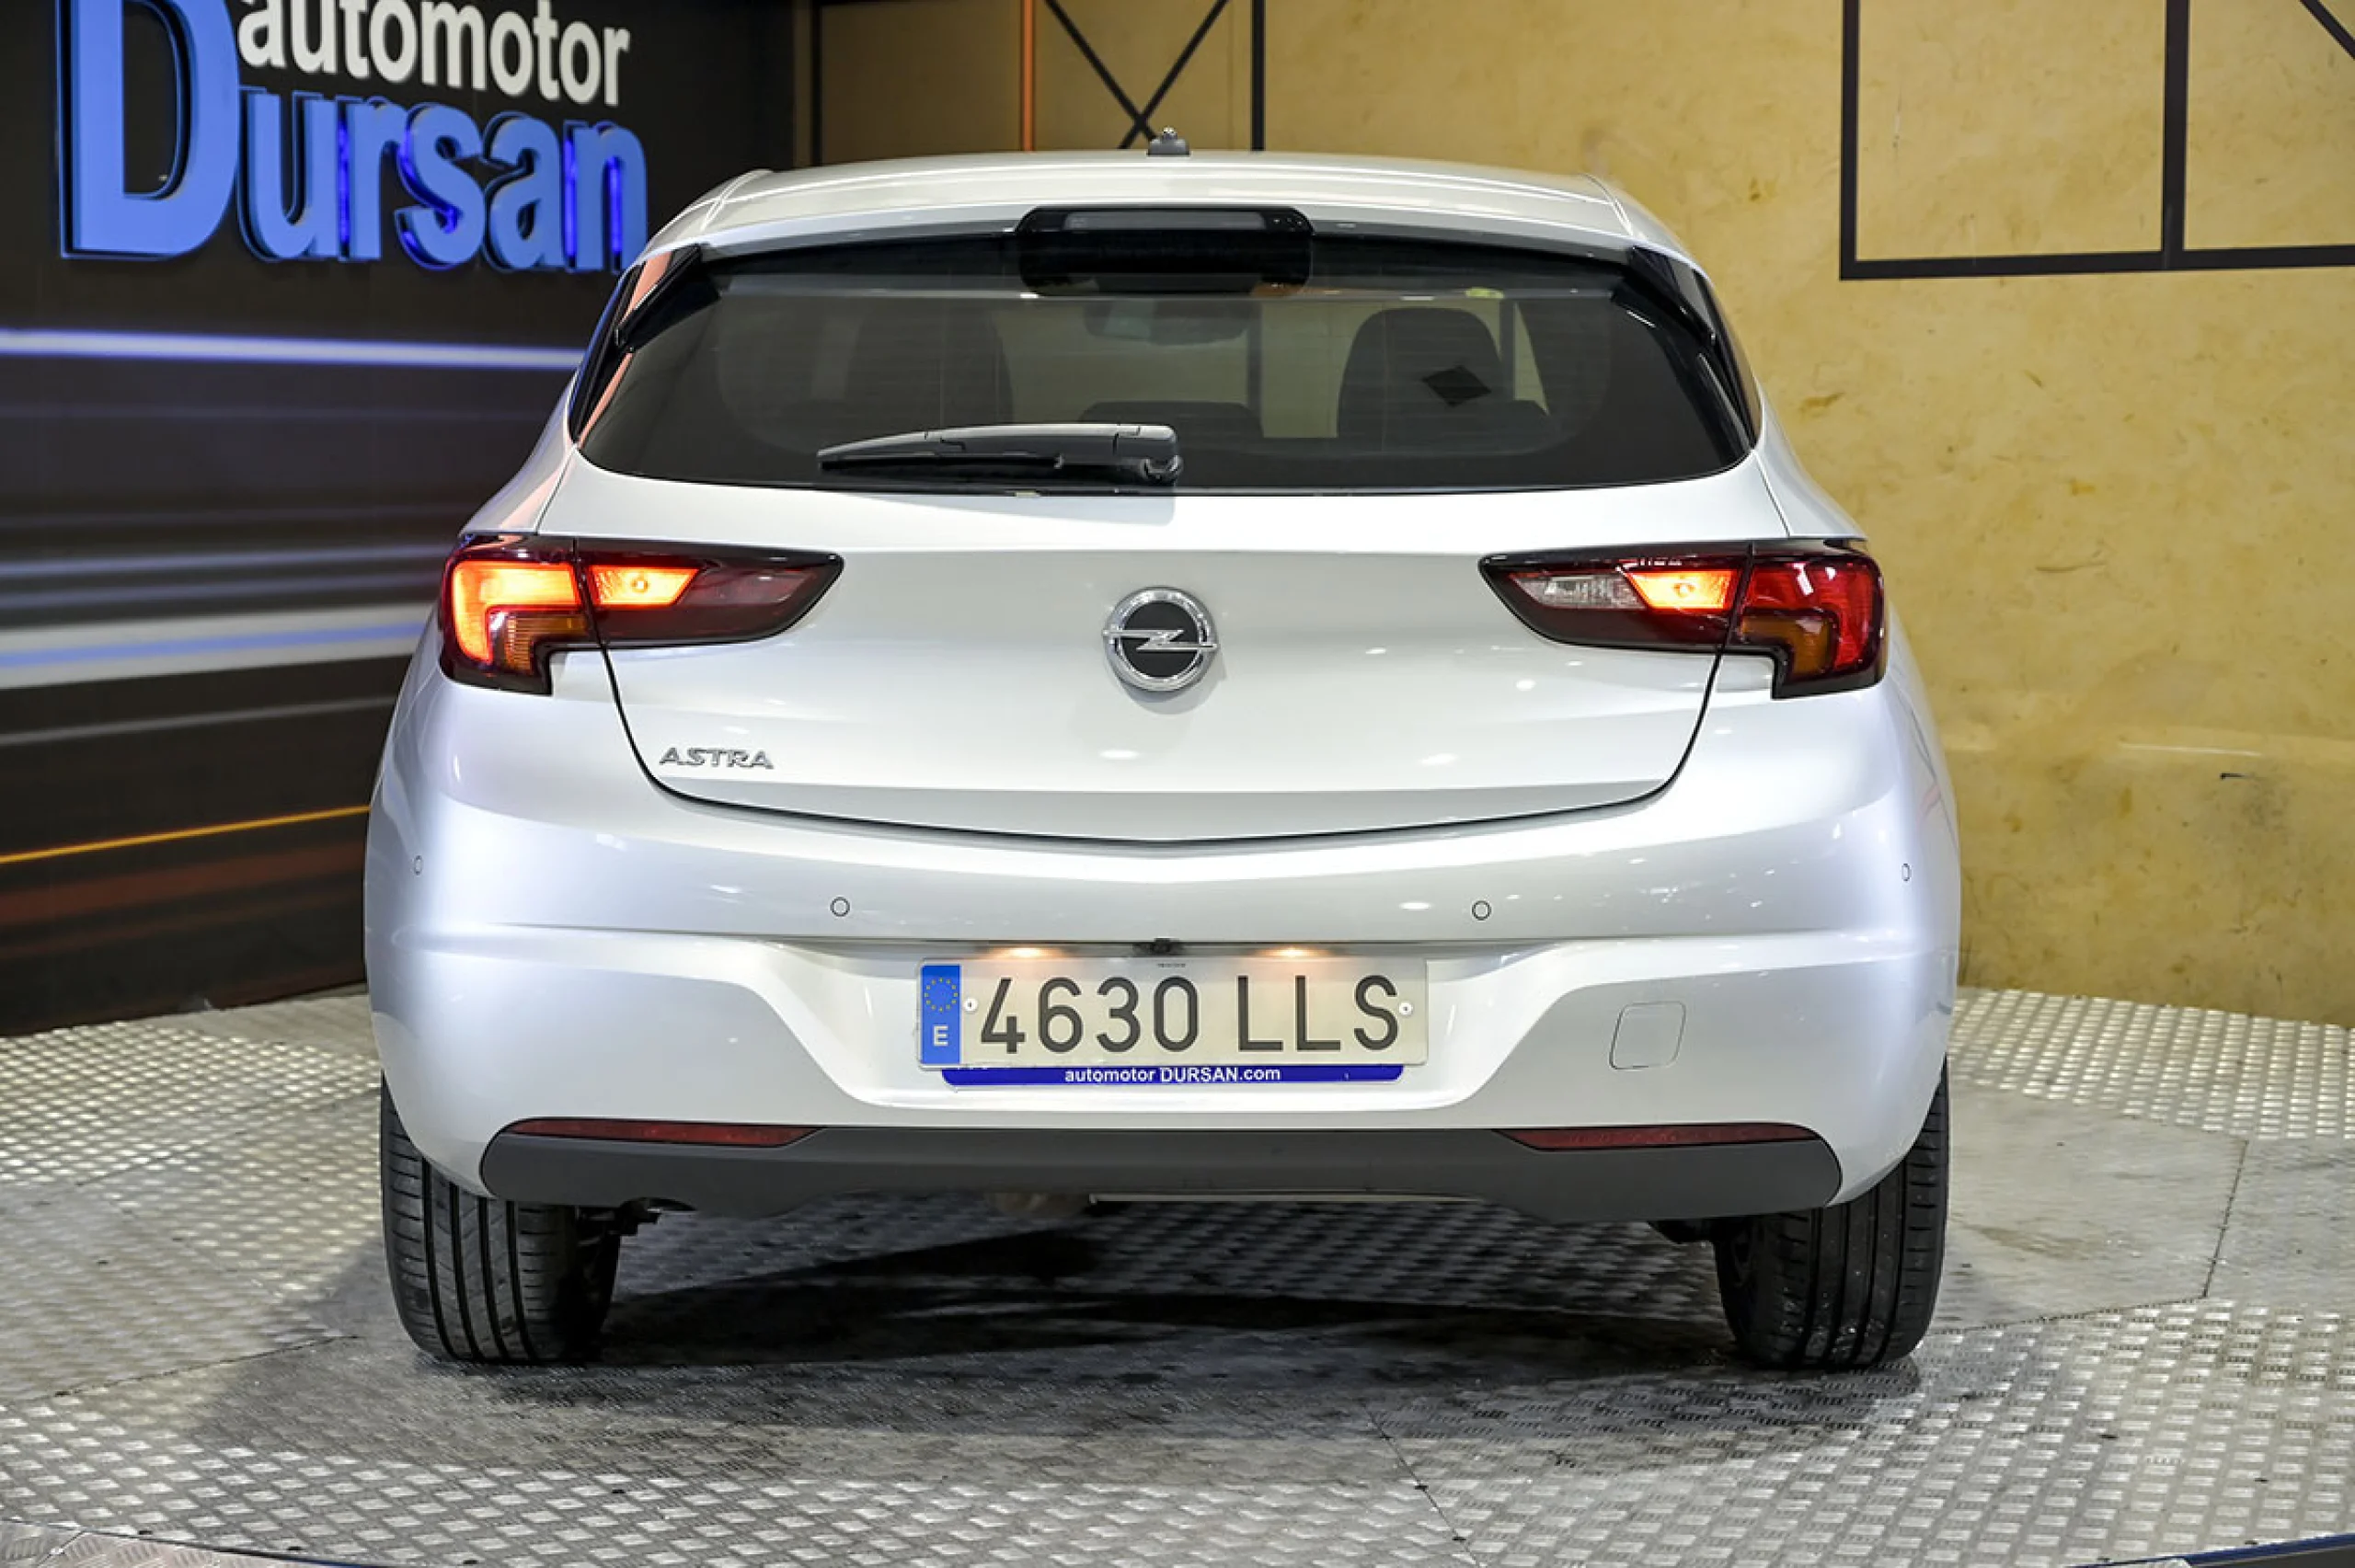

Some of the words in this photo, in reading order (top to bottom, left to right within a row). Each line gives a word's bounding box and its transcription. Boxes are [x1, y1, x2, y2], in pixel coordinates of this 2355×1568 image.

[238, 0, 631, 107] automotor
[58, 0, 647, 272] Dursan
[659, 747, 774, 770] ASTRA
[933, 1025, 948, 1047] E
[981, 976, 1199, 1053] 4630
[1237, 975, 1398, 1051] LLS
[1064, 1068, 1156, 1082] automotor
[1159, 1067, 1281, 1082] DURSAN.com
